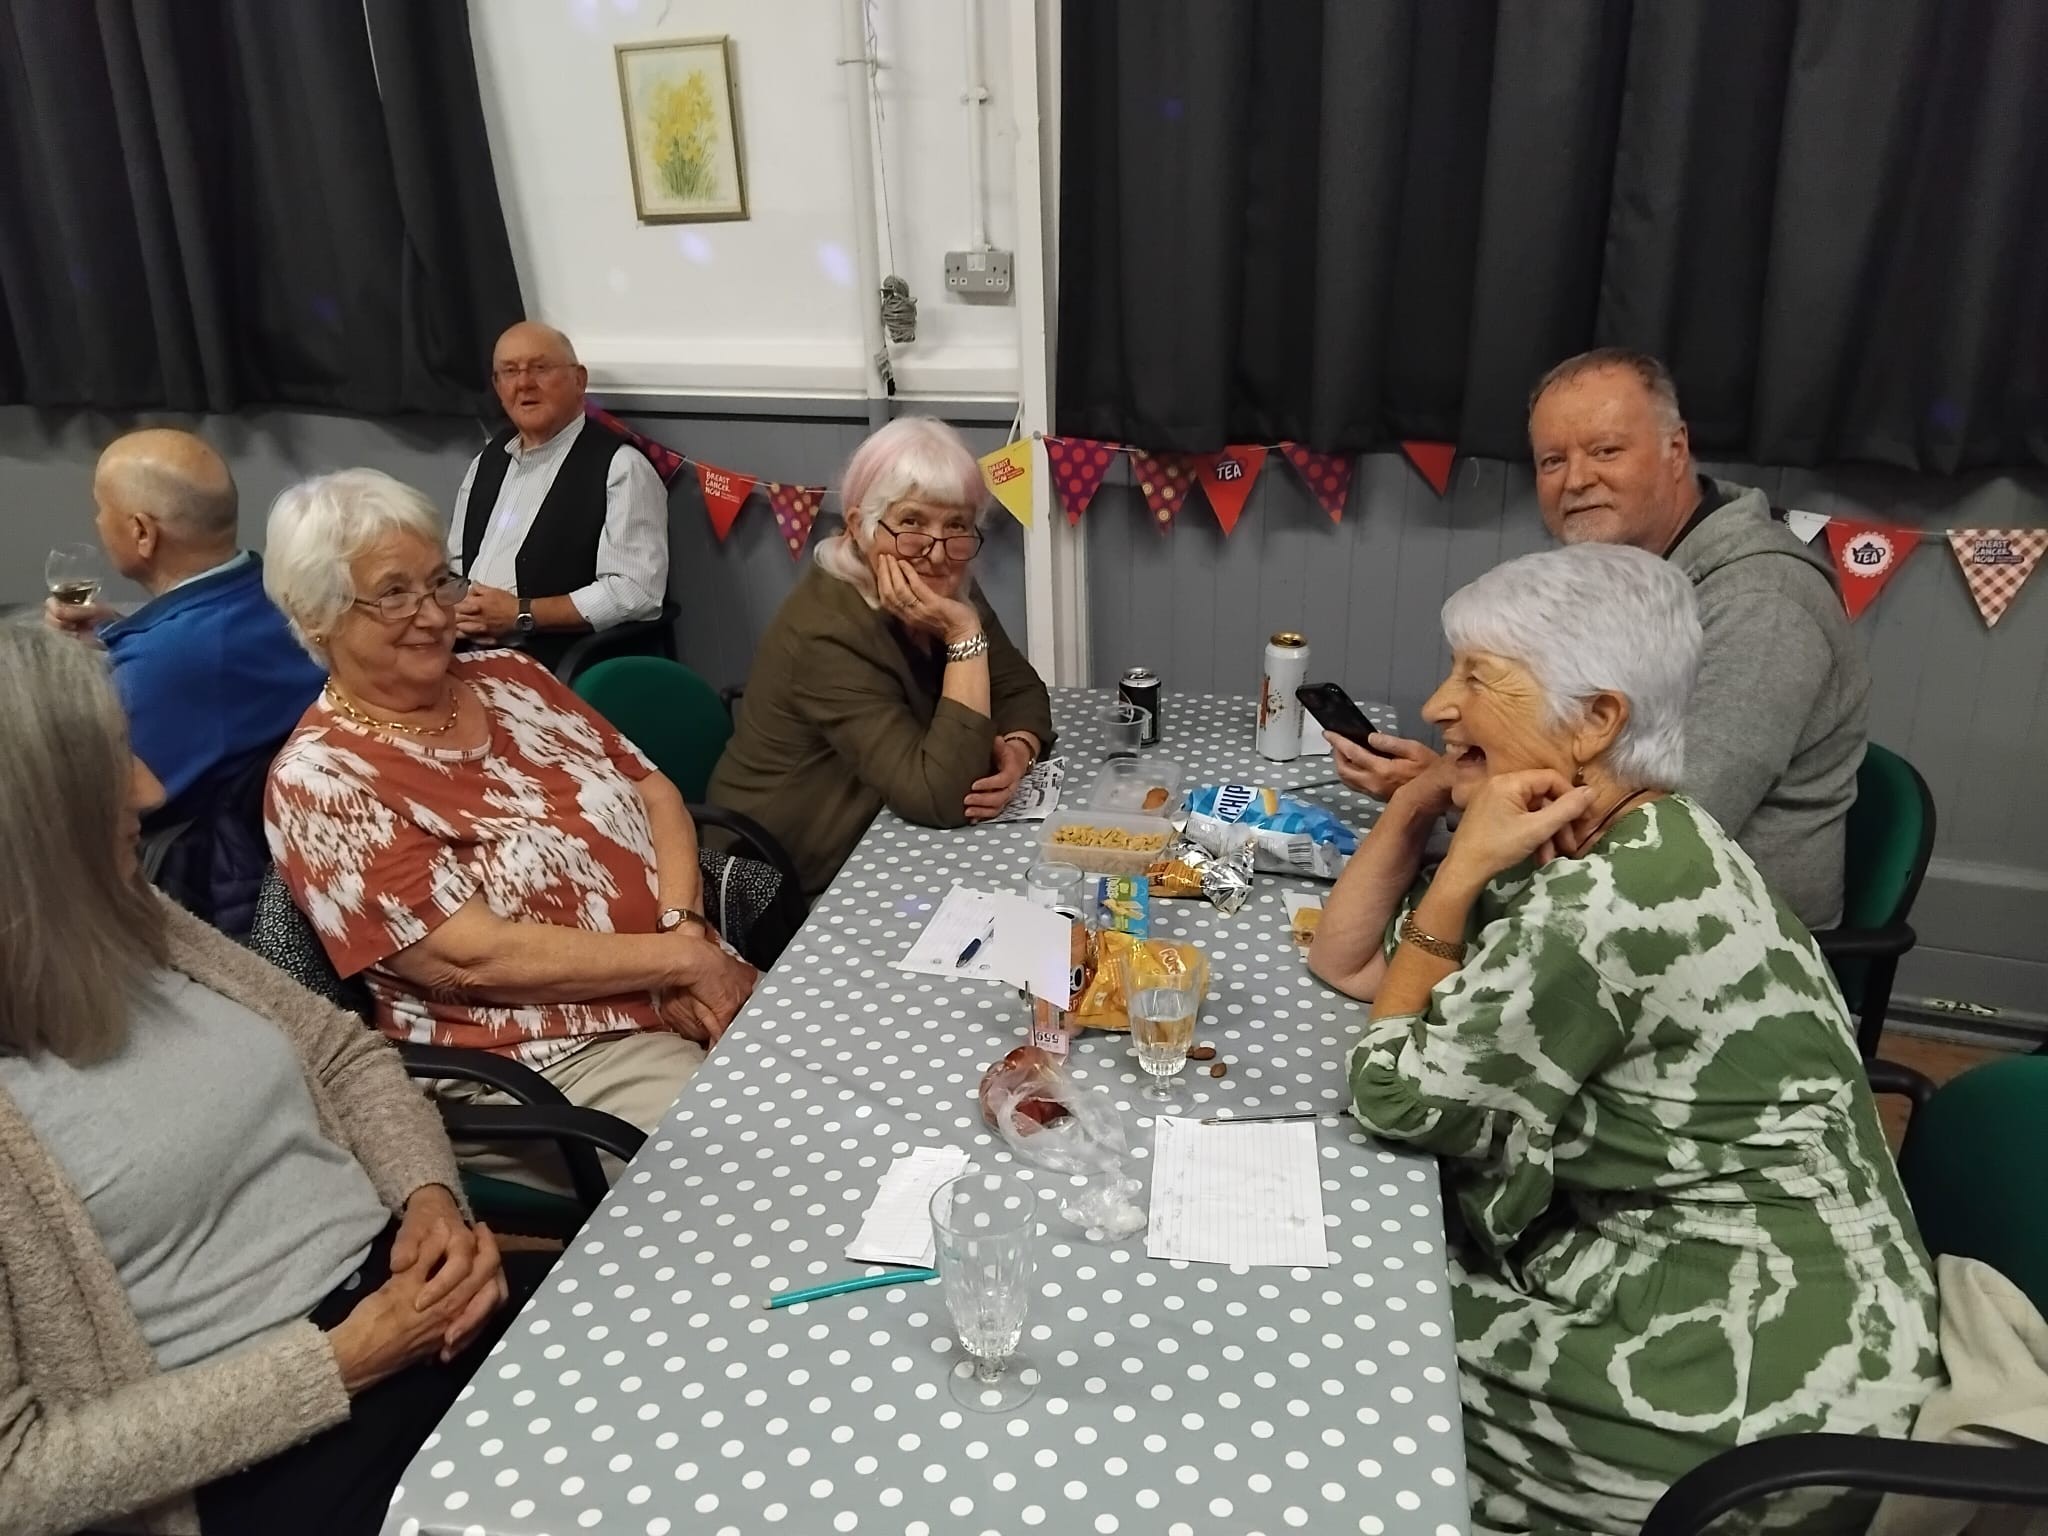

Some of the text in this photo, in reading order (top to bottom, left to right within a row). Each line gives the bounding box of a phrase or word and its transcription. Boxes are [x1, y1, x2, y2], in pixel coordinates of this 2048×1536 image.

[706, 471, 730, 484] BREAST
[1216, 464, 1242, 480] TEA
[705, 479, 731, 492] CANCER
[705, 486, 721, 497] NOW
[1975, 540, 2009, 550] BREAST
[1856, 552, 1879, 563] TEA
[1974, 555, 1995, 563] NOW
[1036, 1031, 1060, 1044] 559
